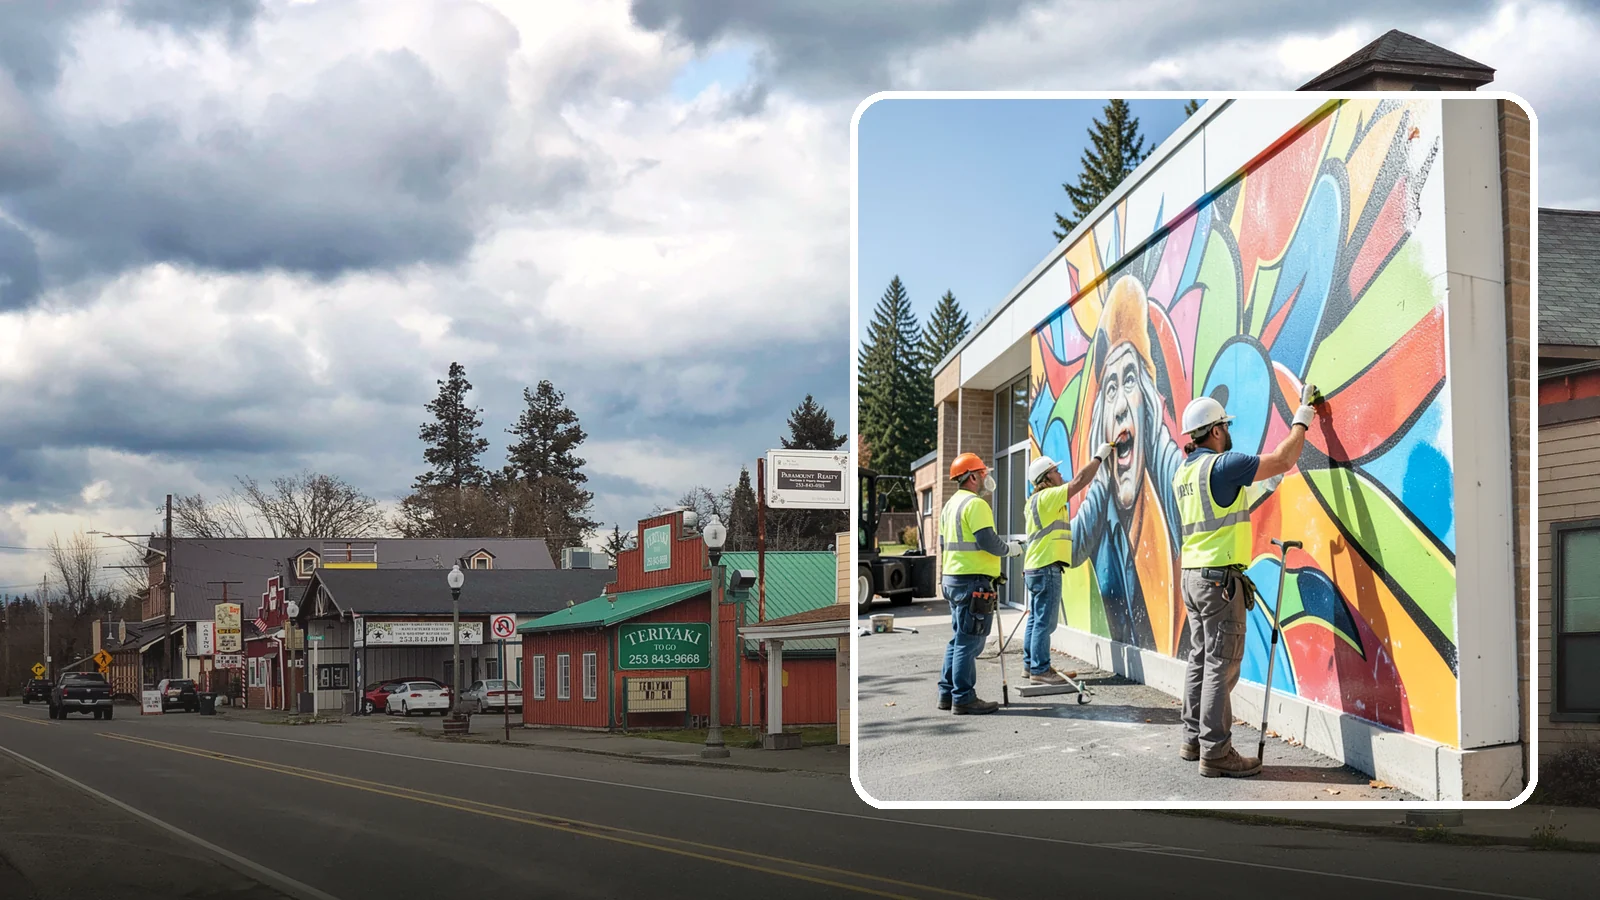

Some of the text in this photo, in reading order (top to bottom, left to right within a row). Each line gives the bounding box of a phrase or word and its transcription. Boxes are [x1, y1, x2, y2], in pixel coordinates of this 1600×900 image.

[625, 627, 702, 646] TERIYAKI
[629, 654, 700, 664] 253 843-9668
[639, 681, 672, 691] TERIYAKI
